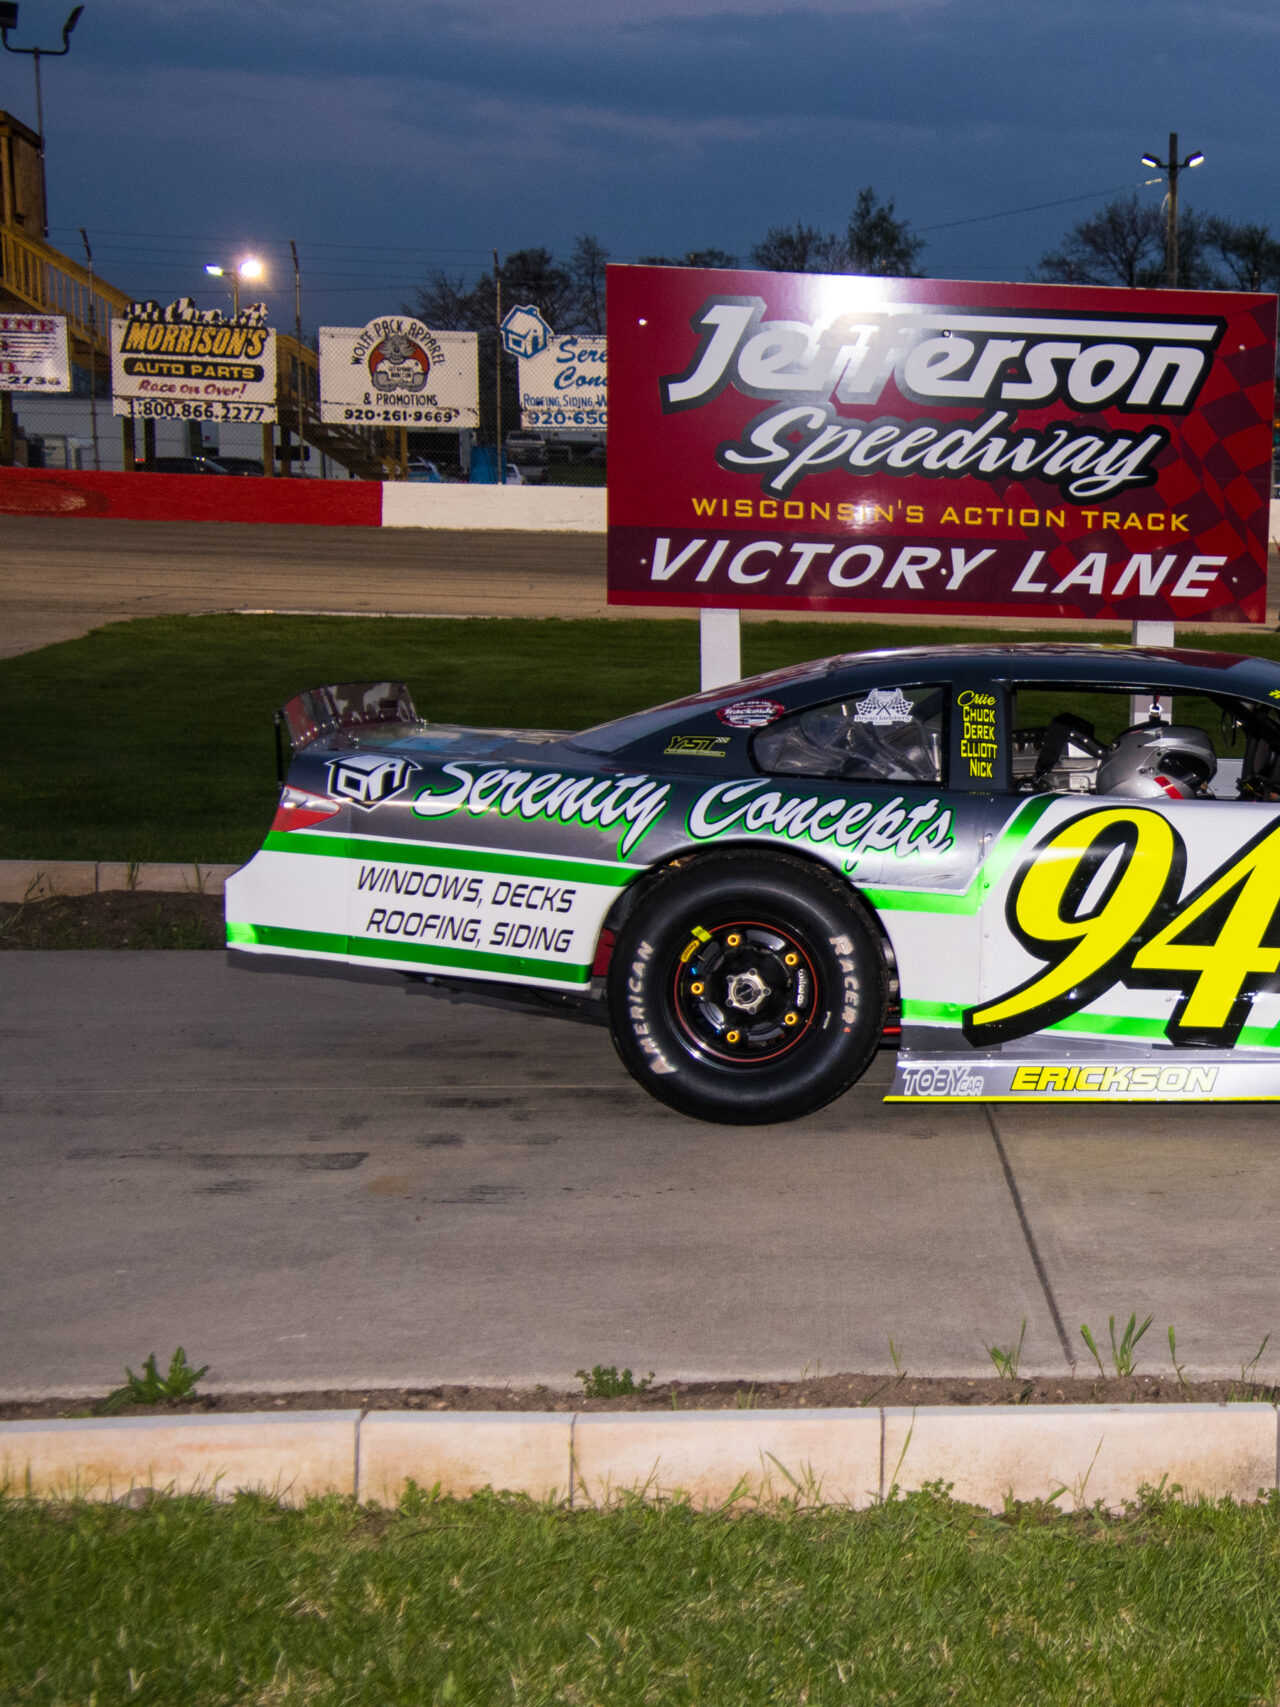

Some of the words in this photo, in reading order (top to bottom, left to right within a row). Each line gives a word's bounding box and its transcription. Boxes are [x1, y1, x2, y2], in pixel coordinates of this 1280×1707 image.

[125, 321, 267, 357] MORRISON'S
[351, 330, 374, 365] WOLFF
[374, 319, 403, 337] PACK
[408, 322, 446, 365] APPAREL
[664, 302, 1220, 410] Jefferson
[133, 361, 185, 375] AUTO
[191, 364, 255, 379] PARTS
[138, 380, 176, 393] Race
[204, 383, 247, 398] Over!
[363, 392, 372, 405] &
[376, 393, 438, 406] PROMOTIONS
[723, 404, 1164, 498] Speedway
[691, 497, 925, 525] WISCONSIN'S
[939, 505, 1068, 528] ACTION
[1080, 509, 1190, 532] TRACK
[649, 536, 996, 591] VICTORY
[1011, 550, 1229, 599] LANE
[963, 706, 996, 723] CHUCK
[964, 722, 996, 740] DEREK
[960, 739, 998, 759] ELLIOTT
[969, 758, 993, 778] NICK
[412, 760, 672, 860] Serenity
[687, 777, 953, 872] Concepts
[358, 866, 483, 909] WINDOWS,
[491, 881, 577, 913] DECKS
[366, 908, 482, 949] ROOFING,
[489, 922, 574, 953] SIDING
[828, 934, 861, 1025] RACER
[628, 940, 678, 1075] AMERICAN
[1010, 1066, 1220, 1092] ERICKSON
